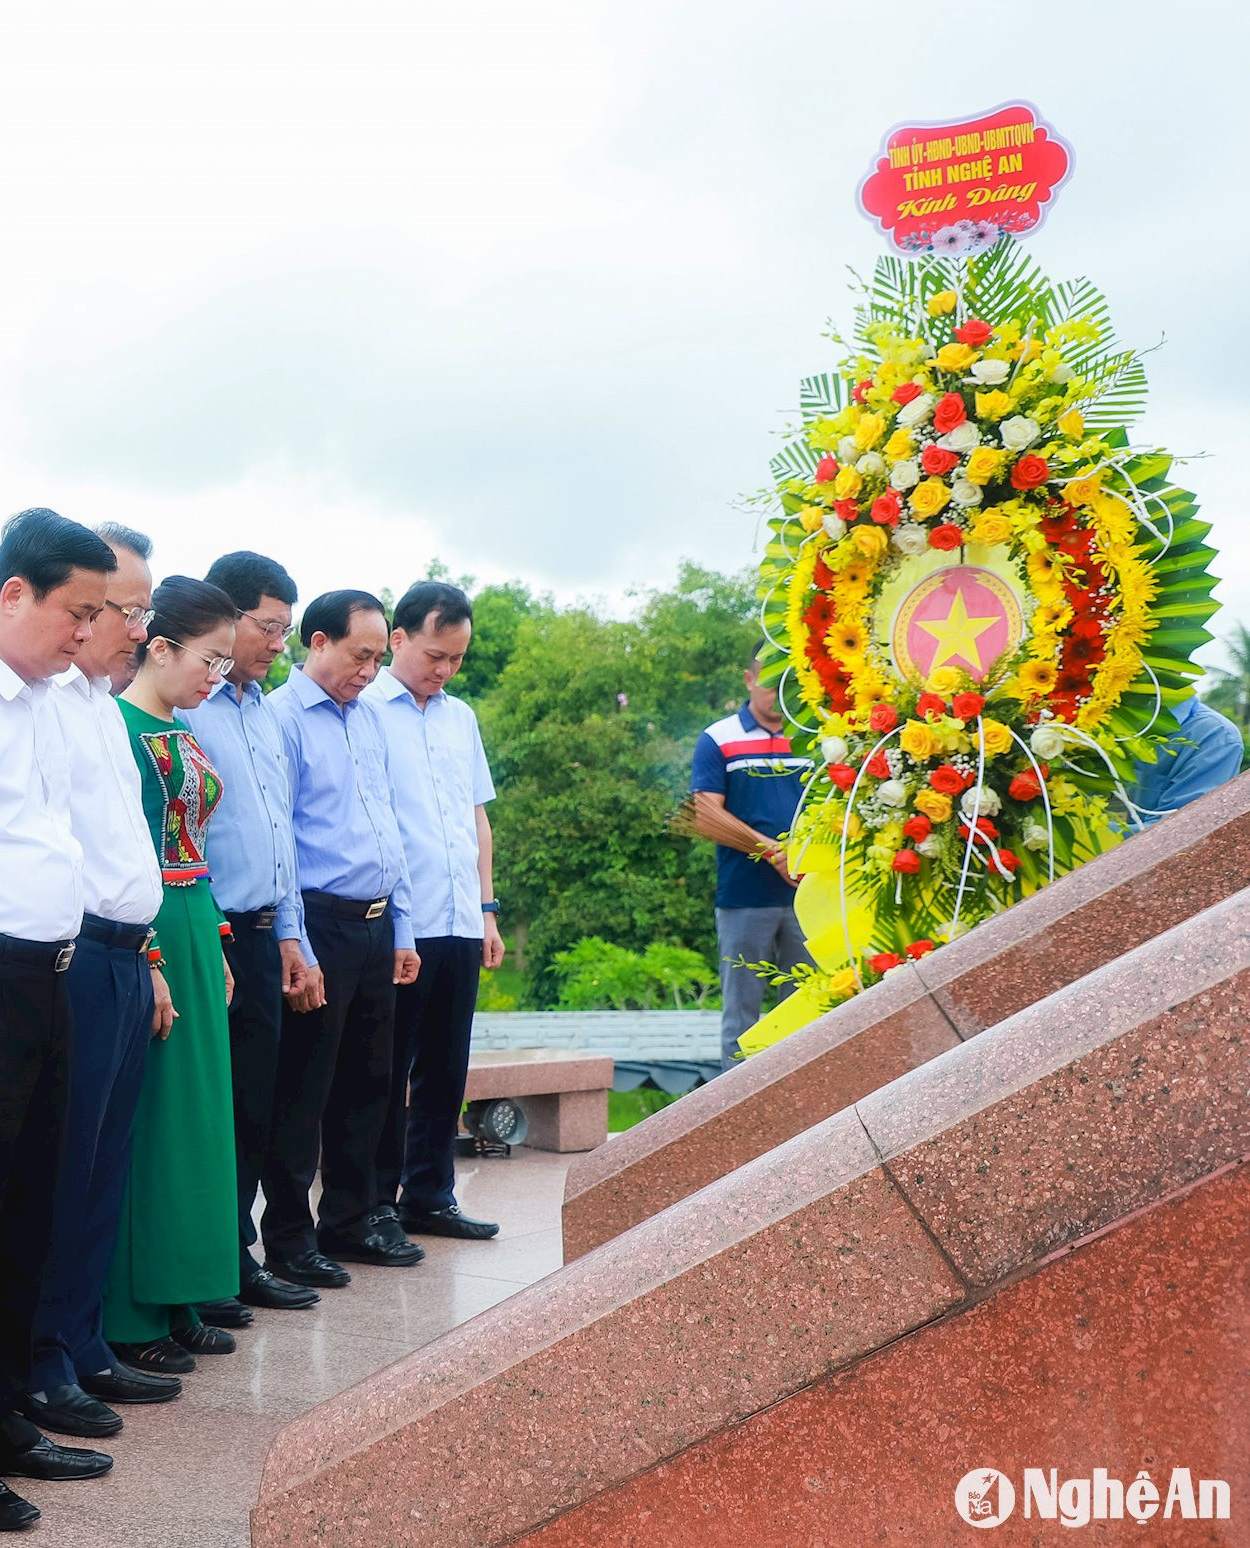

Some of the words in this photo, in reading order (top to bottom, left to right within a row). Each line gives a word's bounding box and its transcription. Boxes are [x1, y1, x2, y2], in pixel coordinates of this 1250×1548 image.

[889, 141, 911, 169] TỈNH
[902, 165, 943, 192] TỈNH
[947, 156, 993, 182] NGHỆ
[998, 153, 1023, 175] AN
[896, 193, 958, 220] Kính
[965, 182, 1038, 209] Dâng
